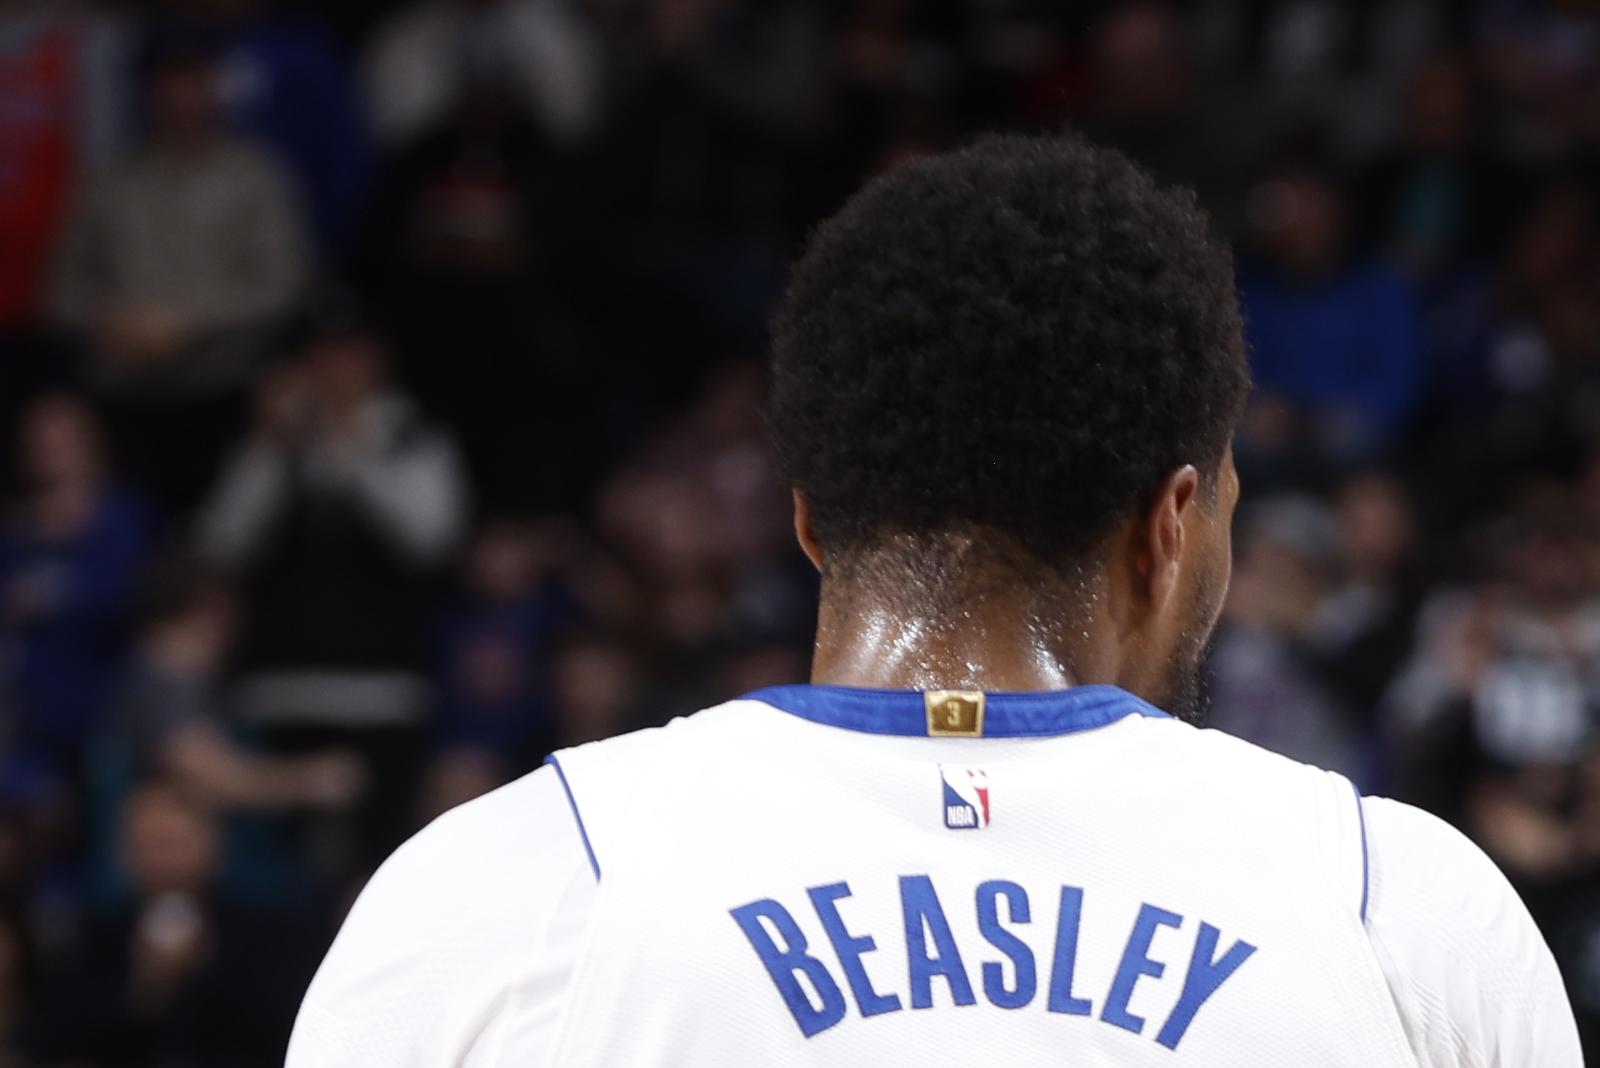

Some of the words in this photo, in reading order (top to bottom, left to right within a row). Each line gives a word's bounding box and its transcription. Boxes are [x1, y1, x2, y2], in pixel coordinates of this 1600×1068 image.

[947, 702, 961, 726] 3
[947, 805, 976, 826] NBA
[729, 874, 1257, 1052] BEASLEY
